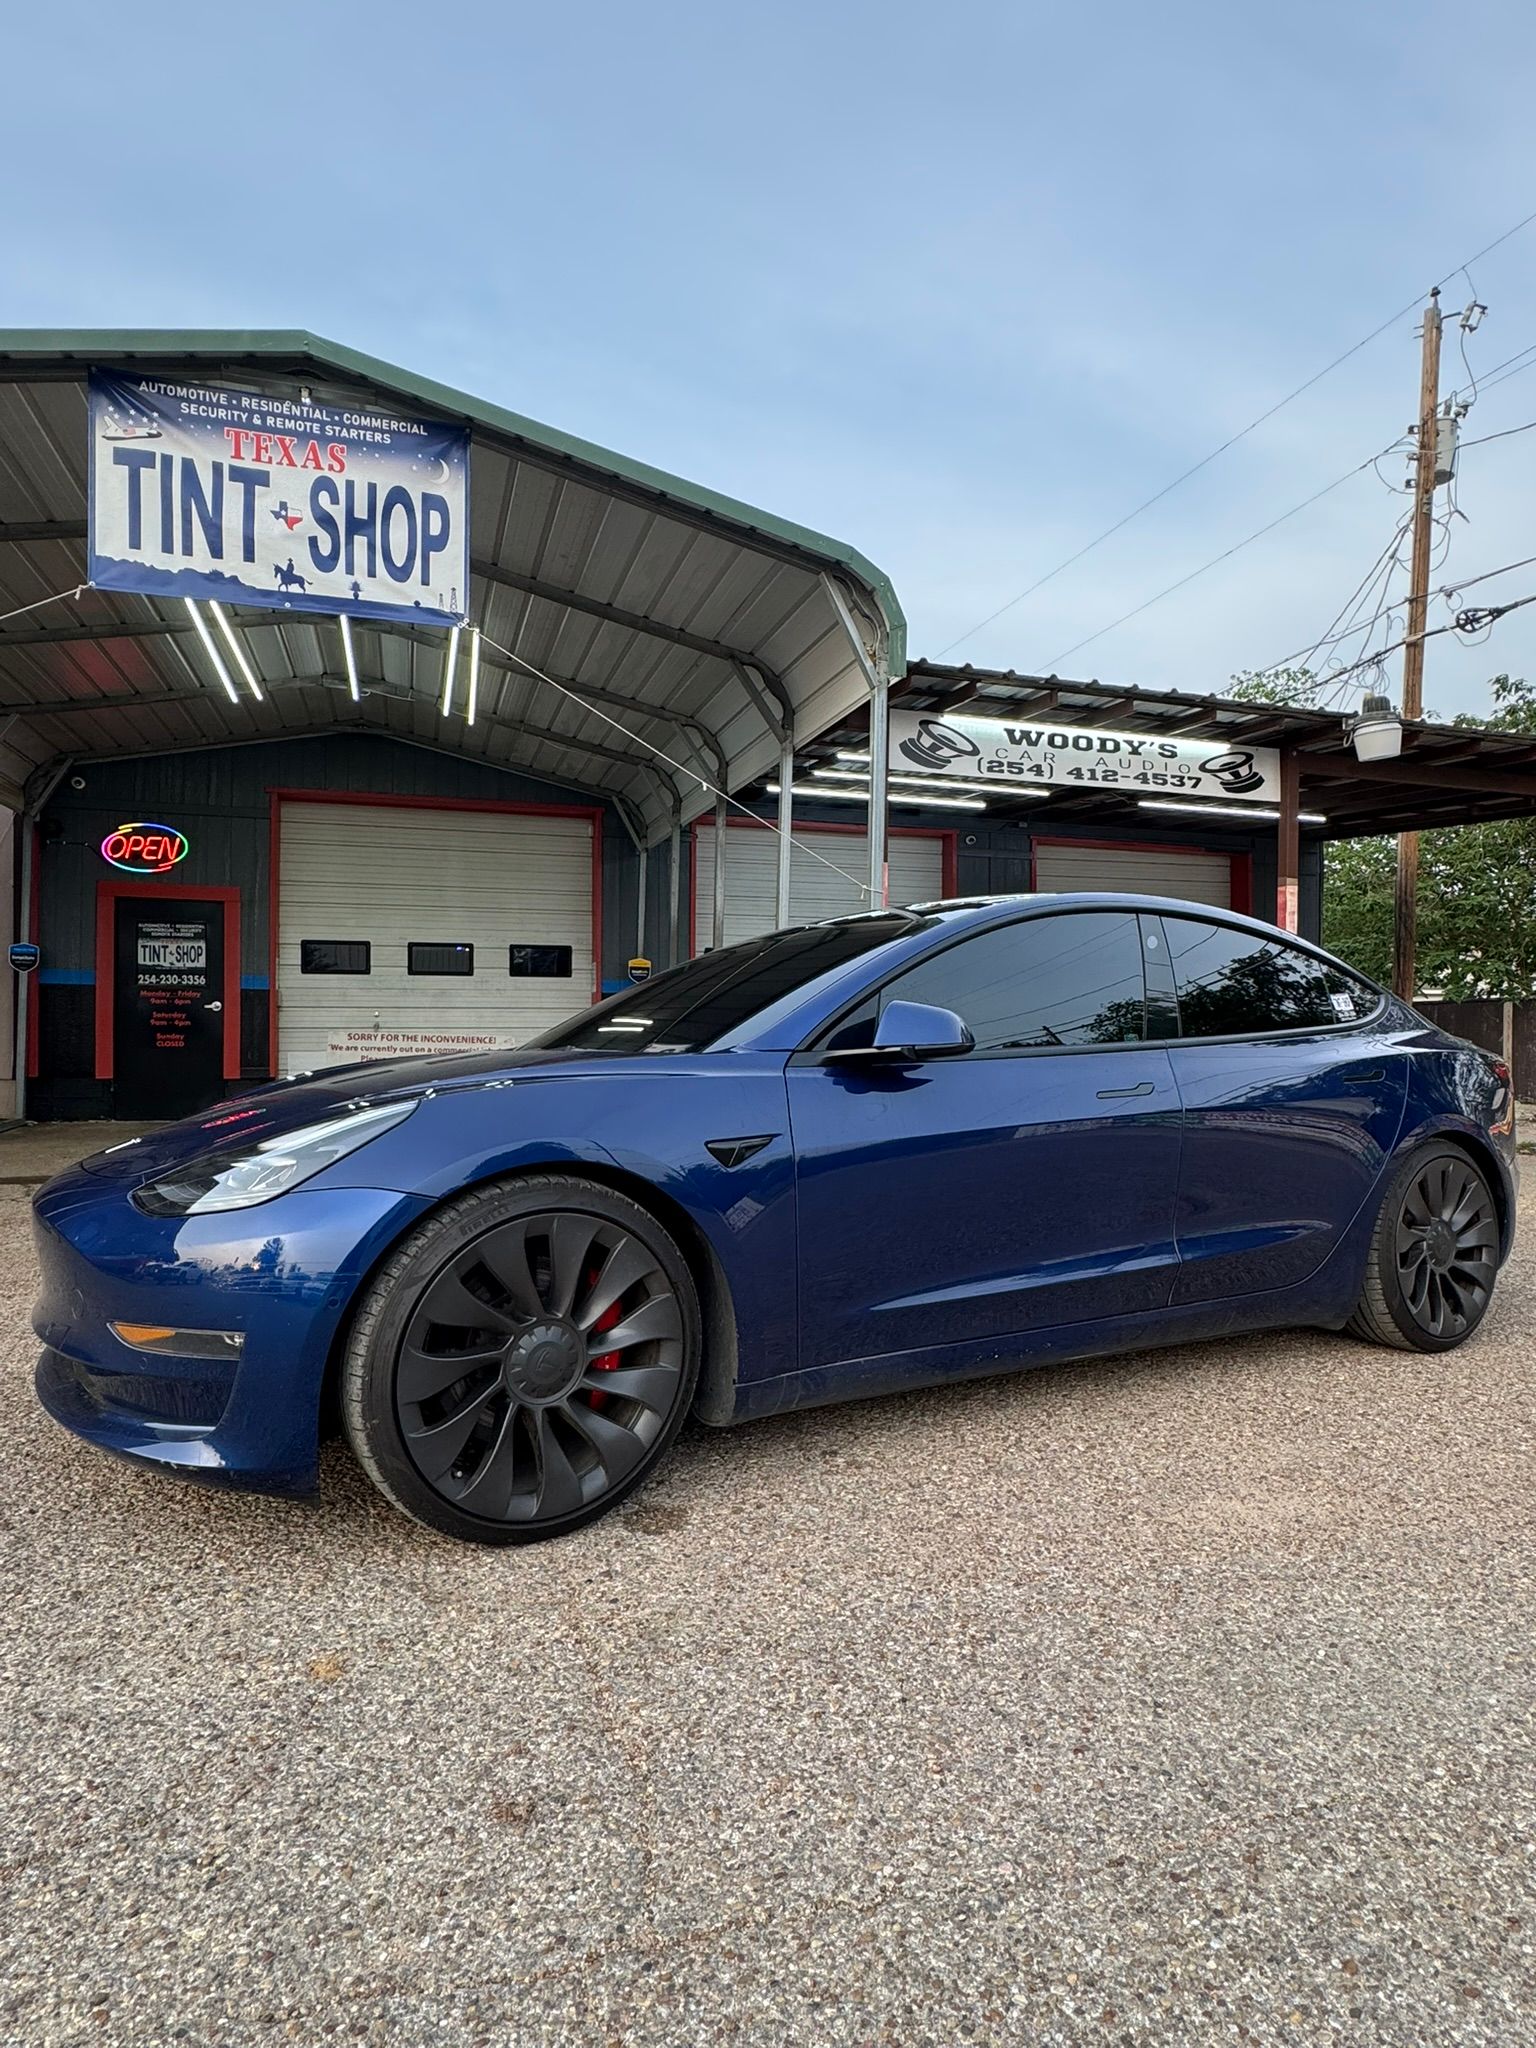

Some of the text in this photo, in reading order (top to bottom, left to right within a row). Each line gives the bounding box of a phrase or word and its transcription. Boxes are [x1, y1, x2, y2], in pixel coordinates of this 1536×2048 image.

[138, 380, 428, 436] AUTOMOTIVE RESIDENTIAL COMMERCIAL
[180, 402, 391, 445] SECURITY & REMOTE STARTERS
[223, 426, 347, 474] TEXAS
[112, 446, 450, 586] TINT SHOP
[1003, 727, 1178, 759] WOODY'S
[977, 757, 1202, 789] (254) 412-4537
[995, 748, 1191, 774] CAR AUDIO
[107, 835, 180, 860] OPEN
[140, 945, 204, 964] TINT SHOP
[137, 974, 207, 986] 254-230-3356
[177, 990, 202, 998] Friday
[152, 1011, 187, 1019] Saturday
[347, 1033, 497, 1044] SORRY FOR THE INCONVENIENCE!
[360, 1044, 397, 1054] currently
